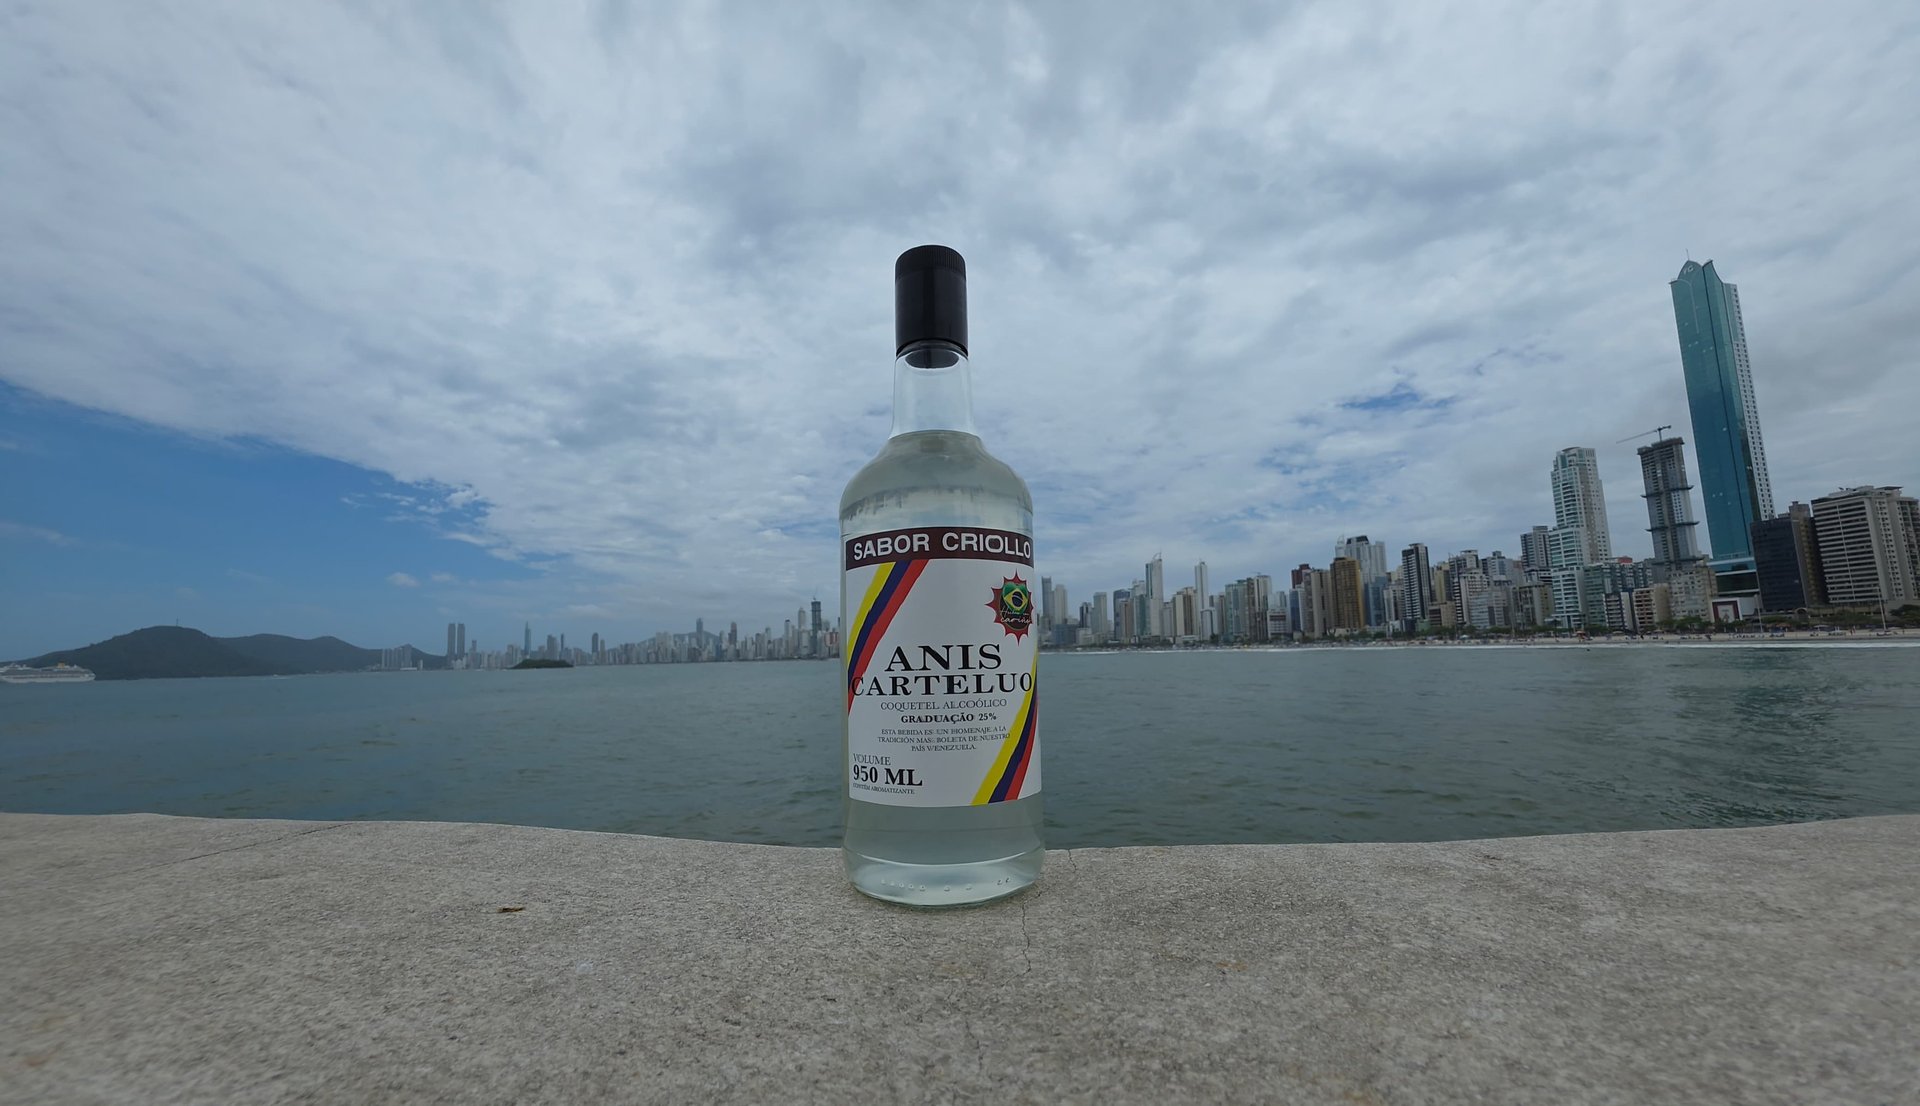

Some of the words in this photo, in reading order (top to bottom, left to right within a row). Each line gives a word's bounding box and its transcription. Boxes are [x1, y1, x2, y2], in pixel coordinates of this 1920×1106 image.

[853, 533, 930, 561] SABOR
[942, 532, 1031, 559] CRIOLLO
[884, 643, 1002, 672] ANIS
[851, 672, 1032, 696] CARTELUO
[881, 701, 940, 712] COQUETEL
[943, 698, 1007, 710] ALCOÓLICO
[901, 712, 974, 724] GRADUAÇÃO
[978, 712, 997, 721] 25%
[979, 733, 1011, 741] NUESTRO
[853, 753, 891, 766] VOLUME
[853, 764, 878, 783] 950
[884, 767, 923, 786] ML
